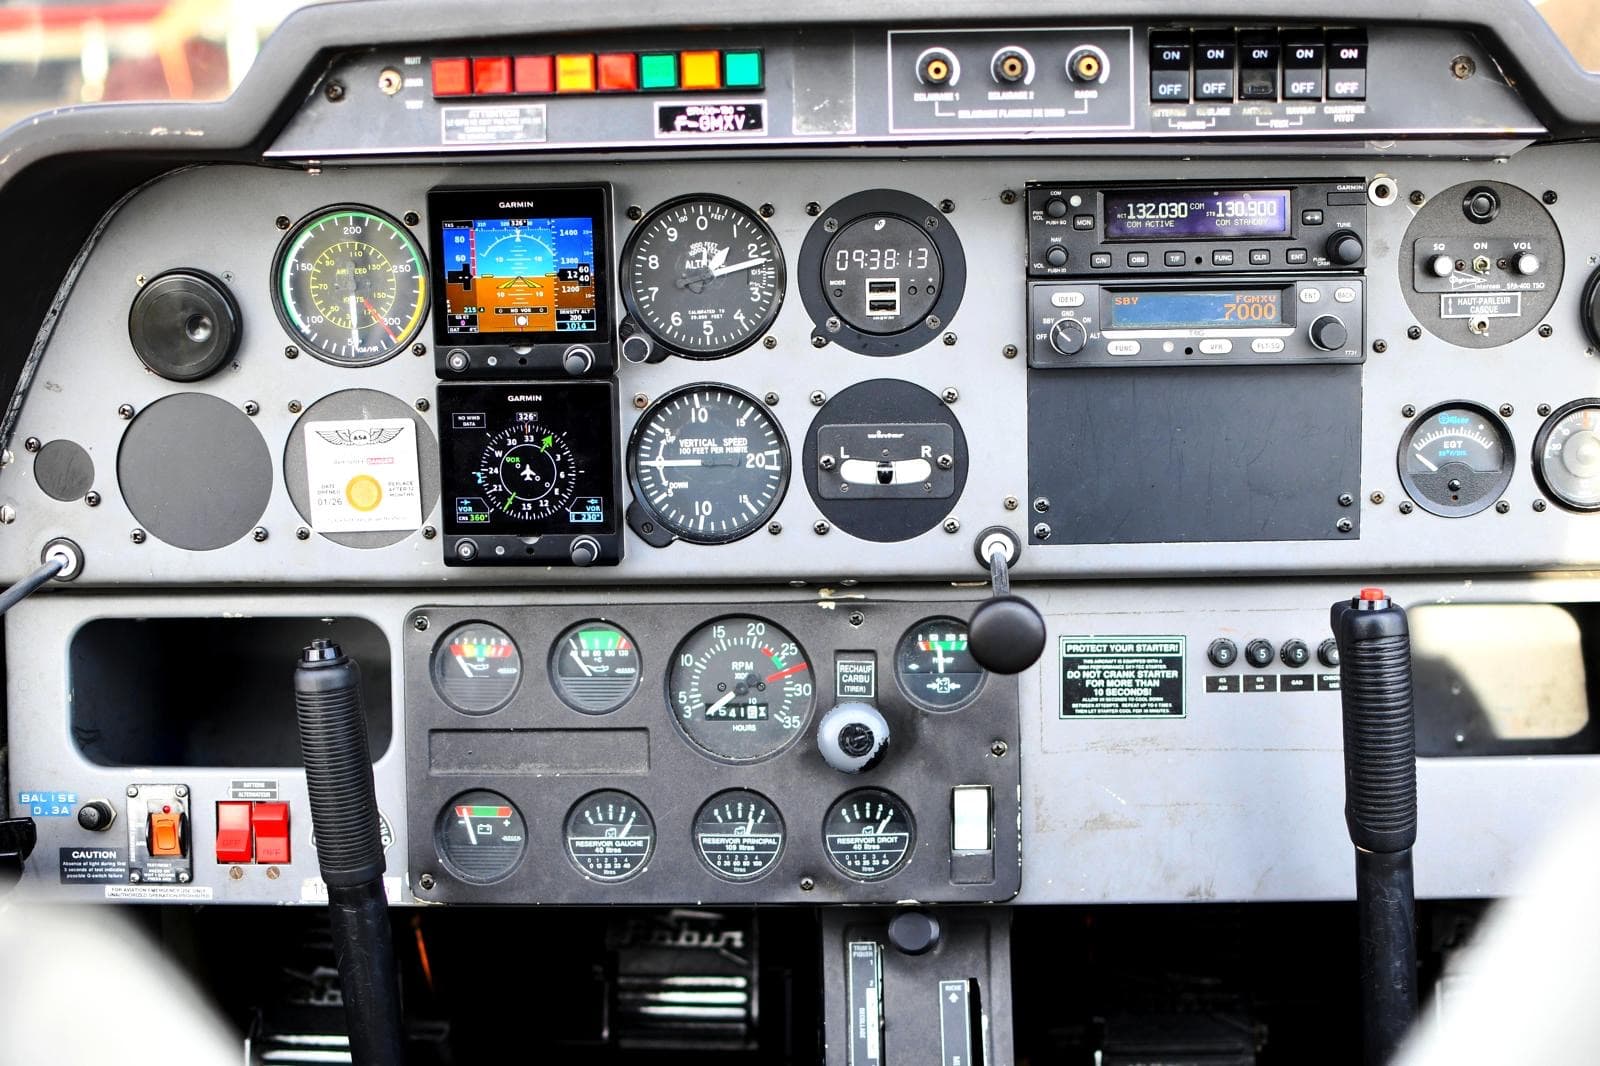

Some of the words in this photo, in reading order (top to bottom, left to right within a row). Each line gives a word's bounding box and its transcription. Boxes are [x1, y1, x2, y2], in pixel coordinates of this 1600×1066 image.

[1162, 51, 1180, 60] ON
[1206, 50, 1224, 59] ON
[1252, 50, 1268, 59] ON
[1296, 49, 1314, 58] ON
[1340, 49, 1358, 59] ON
[1158, 84, 1182, 95] OFF
[1202, 83, 1226, 94] OFF
[1291, 82, 1315, 93] OFF
[1334, 82, 1360, 94] OFF
[674, 114, 746, 131] F-GMXV
[1127, 202, 1188, 219] 132.030
[1216, 201, 1276, 218] 130.900
[696, 216, 708, 230] 0
[710, 213, 726, 222] FEET
[666, 227, 678, 242] 9
[747, 244, 759, 258] 2
[296, 263, 313, 271] 150
[392, 264, 411, 272] 250
[648, 255, 659, 270] 8
[648, 287, 659, 302] 7
[750, 287, 761, 302] 3
[1114, 297, 1140, 305] SBY
[1457, 296, 1511, 306] HAUT-PARLEUR
[1224, 303, 1276, 320] 7000
[1470, 306, 1499, 314] CASQUE
[307, 316, 324, 324] 100
[670, 311, 682, 326] 6
[703, 321, 714, 335] 5
[691, 408, 708, 423] 10
[867, 430, 904, 439] winter
[679, 438, 718, 447] VERTICAL
[723, 438, 748, 446] SPEED
[840, 446, 850, 458] L
[921, 445, 932, 458] R
[745, 453, 765, 468] 20
[317, 498, 343, 506] 01/26
[695, 501, 712, 516] 10
[713, 626, 726, 638] 15
[747, 623, 765, 636] 20
[781, 643, 798, 656] 25
[1066, 644, 1108, 652] PROTECT
[1109, 644, 1134, 652] YOUR
[1135, 644, 1178, 652] STARTER!
[681, 654, 693, 667] 10
[731, 662, 754, 671] RPM
[839, 664, 872, 673] RECHAUF
[842, 675, 870, 683] CARBU
[1066, 671, 1081, 679] DO
[1082, 670, 1102, 679] NOT
[1103, 670, 1135, 678] CRANK
[1136, 670, 1178, 678] STARTER
[1086, 679, 1104, 687] FOR
[1106, 679, 1133, 687] MORE
[1134, 679, 1160, 687] THAN
[793, 684, 812, 696] 30
[844, 685, 866, 693] (TIRER)
[1093, 688, 1104, 696] 10
[1105, 688, 1152, 696] SECONDS!
[678, 691, 687, 704] 5
[682, 706, 692, 718] 3
[782, 716, 800, 728] 35
[21, 794, 76, 803] BALISE
[33, 806, 69, 815] 0.3A
